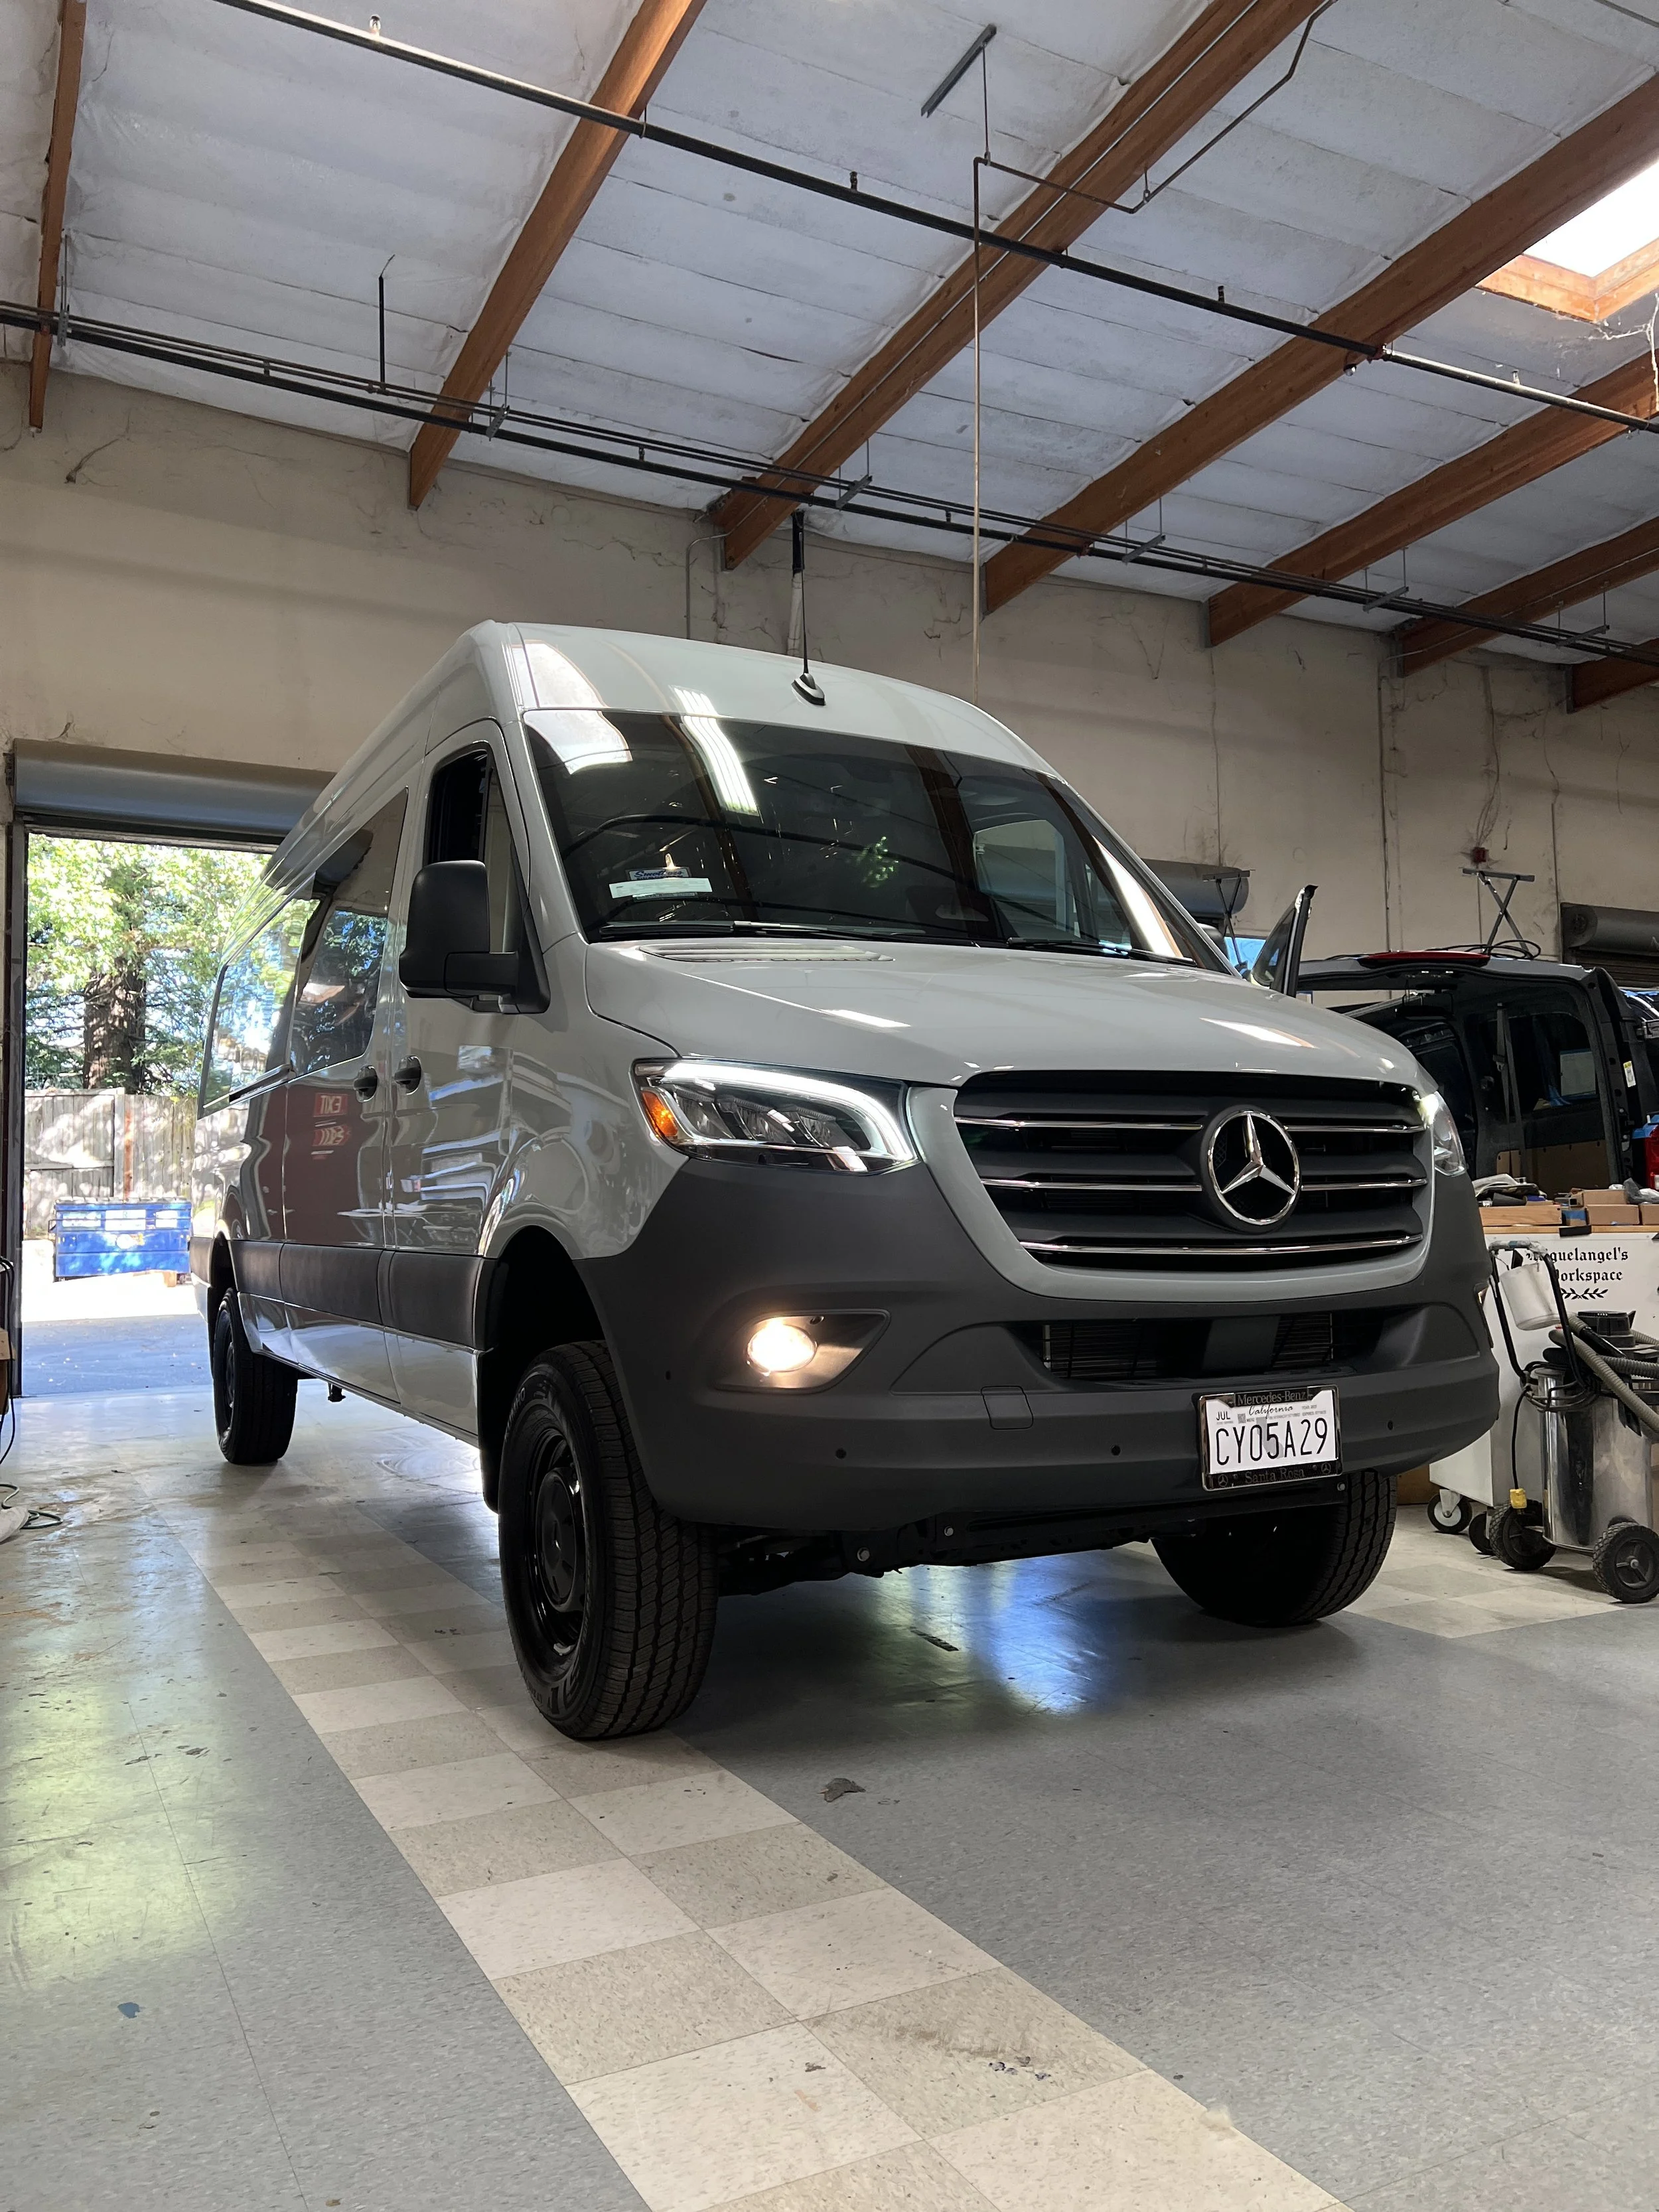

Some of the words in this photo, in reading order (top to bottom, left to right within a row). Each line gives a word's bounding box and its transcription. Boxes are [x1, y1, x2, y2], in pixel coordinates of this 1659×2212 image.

[1238, 1390, 1306, 1406] Mercedes-Benz
[1216, 1411, 1230, 1421] JUL
[1249, 1404, 1293, 1419] California
[1216, 1418, 1328, 1465] CY05A29
[1245, 1468, 1275, 1484] Santa
[1279, 1467, 1305, 1480] Rosa
